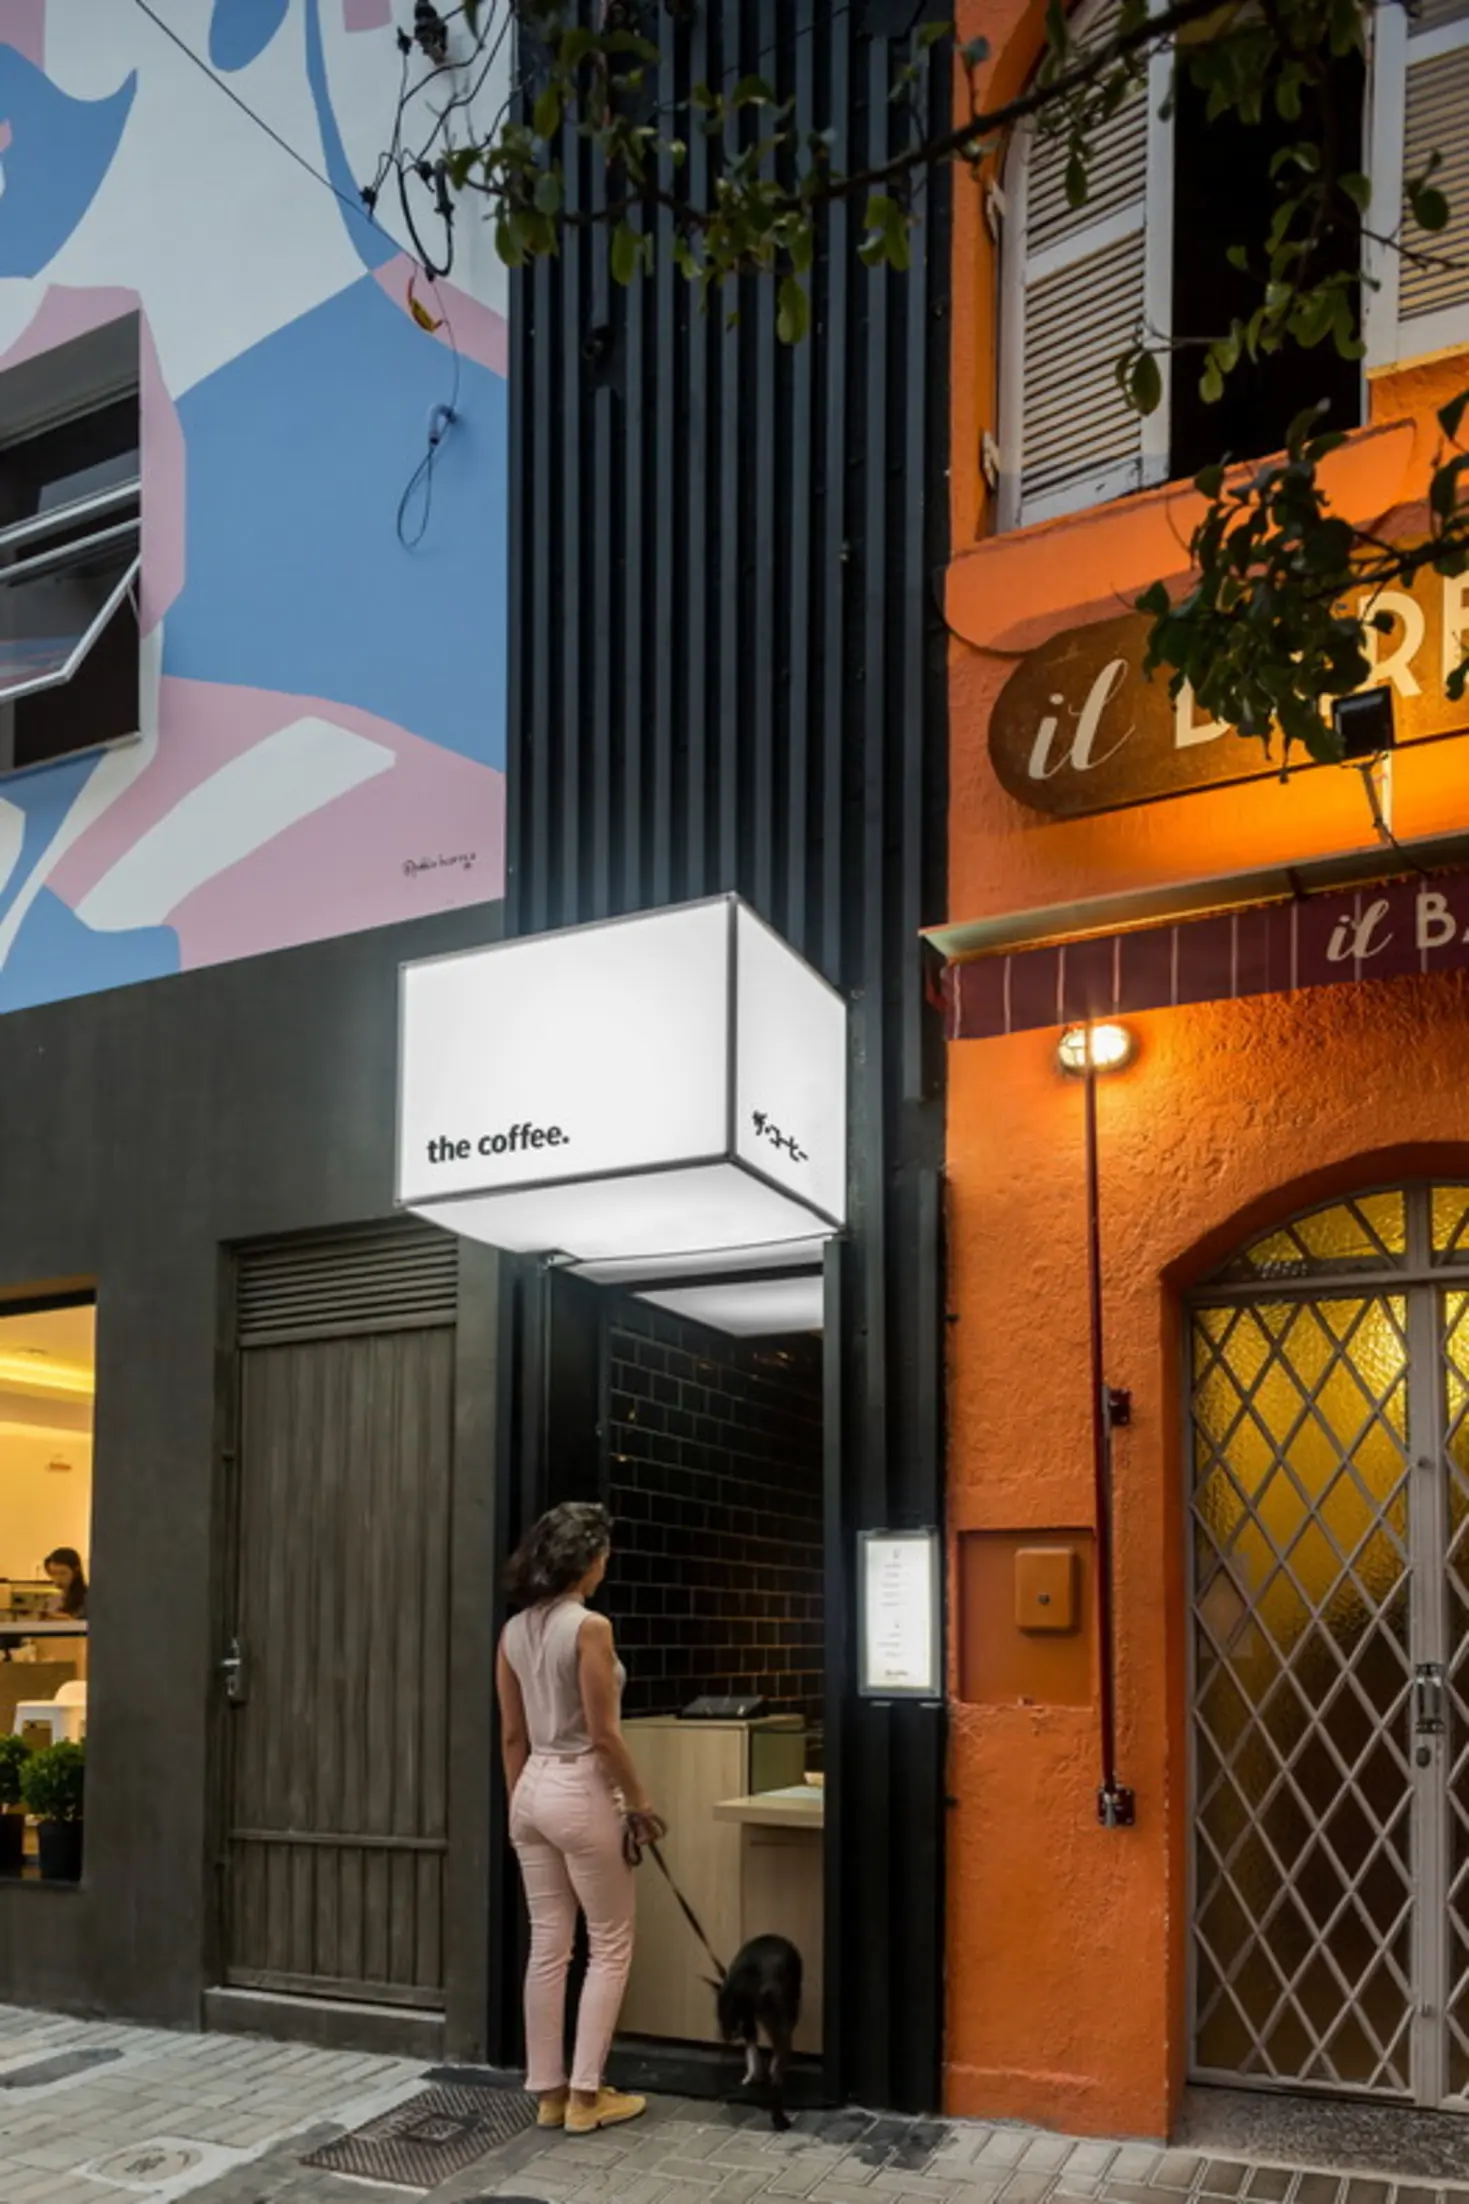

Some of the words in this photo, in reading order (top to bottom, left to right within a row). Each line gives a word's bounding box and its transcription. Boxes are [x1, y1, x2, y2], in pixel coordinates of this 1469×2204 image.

[1028, 658, 1136, 779] il
[1326, 898, 1394, 962] il
[1416, 891, 1469, 950] B
[427, 1134, 471, 1164] the
[477, 1121, 570, 1156] coffee.
